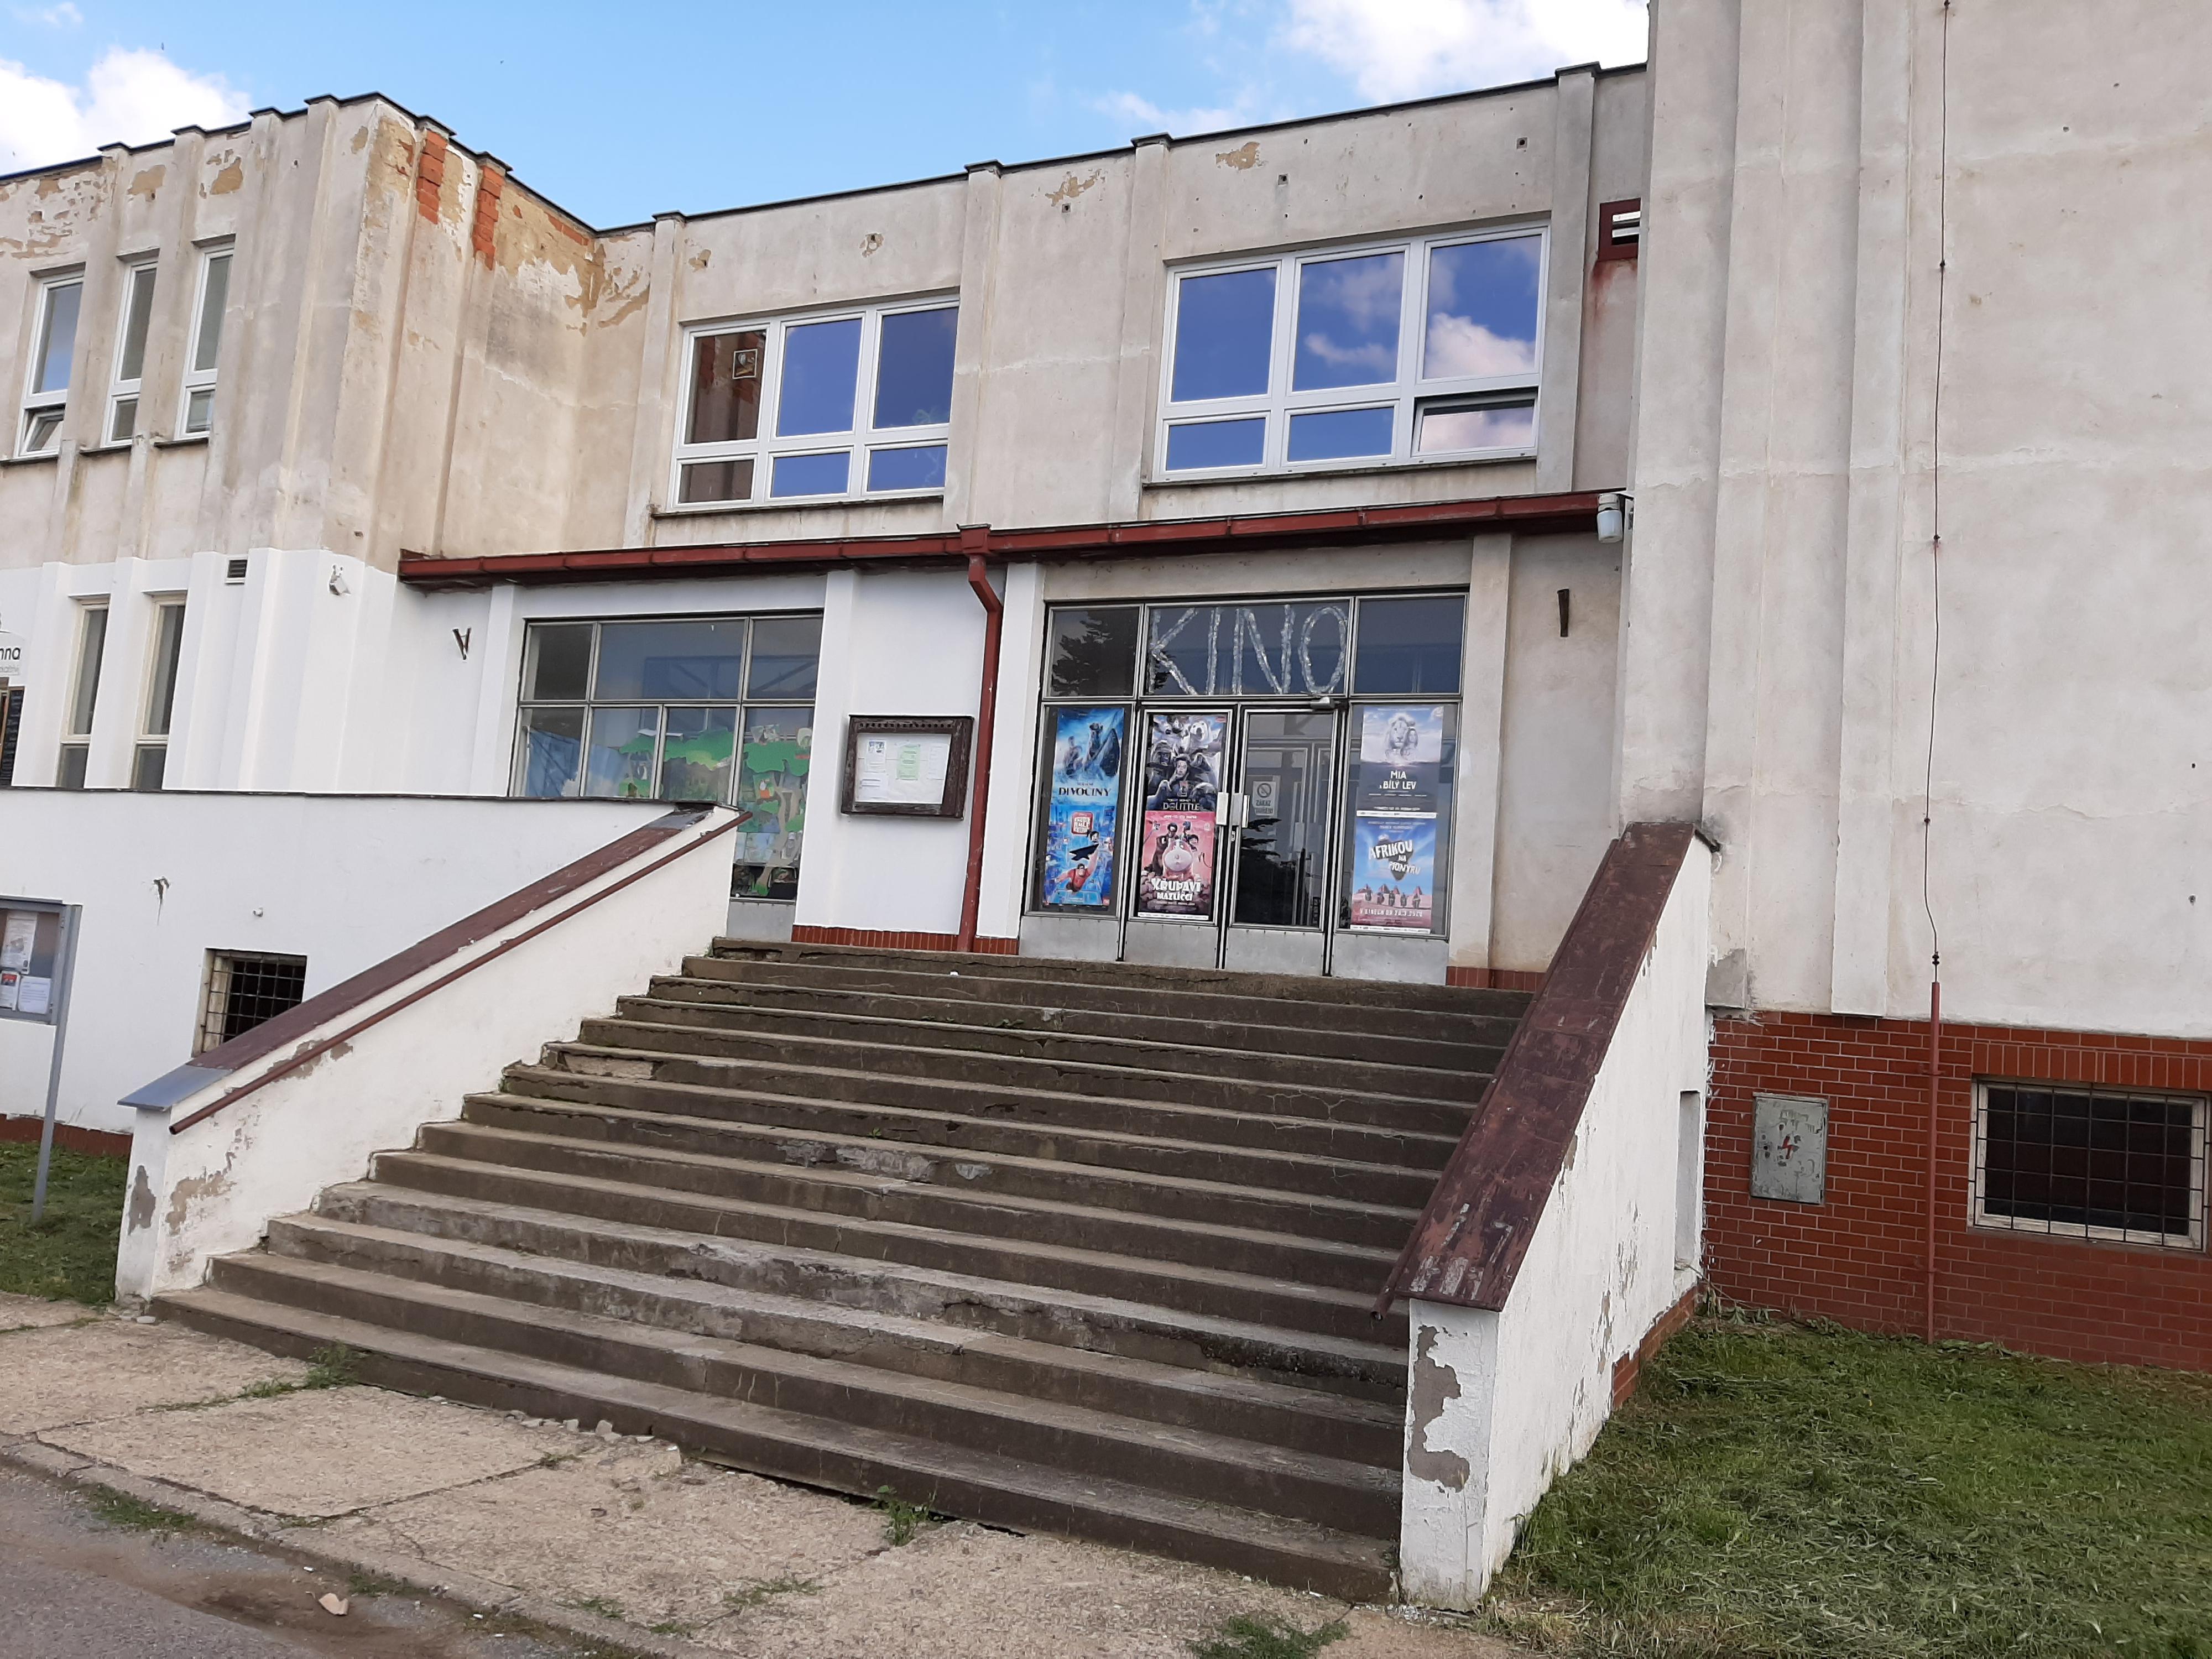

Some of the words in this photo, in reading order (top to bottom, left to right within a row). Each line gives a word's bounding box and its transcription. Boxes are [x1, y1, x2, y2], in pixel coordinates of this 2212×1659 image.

[1147, 604, 1348, 696] KINO
[1390, 770, 1407, 779] MIA
[1402, 781, 1417, 790] LEV
[1163, 802, 1200, 810] DOLITTLE
[1369, 839, 1413, 860] AFRIKOU
